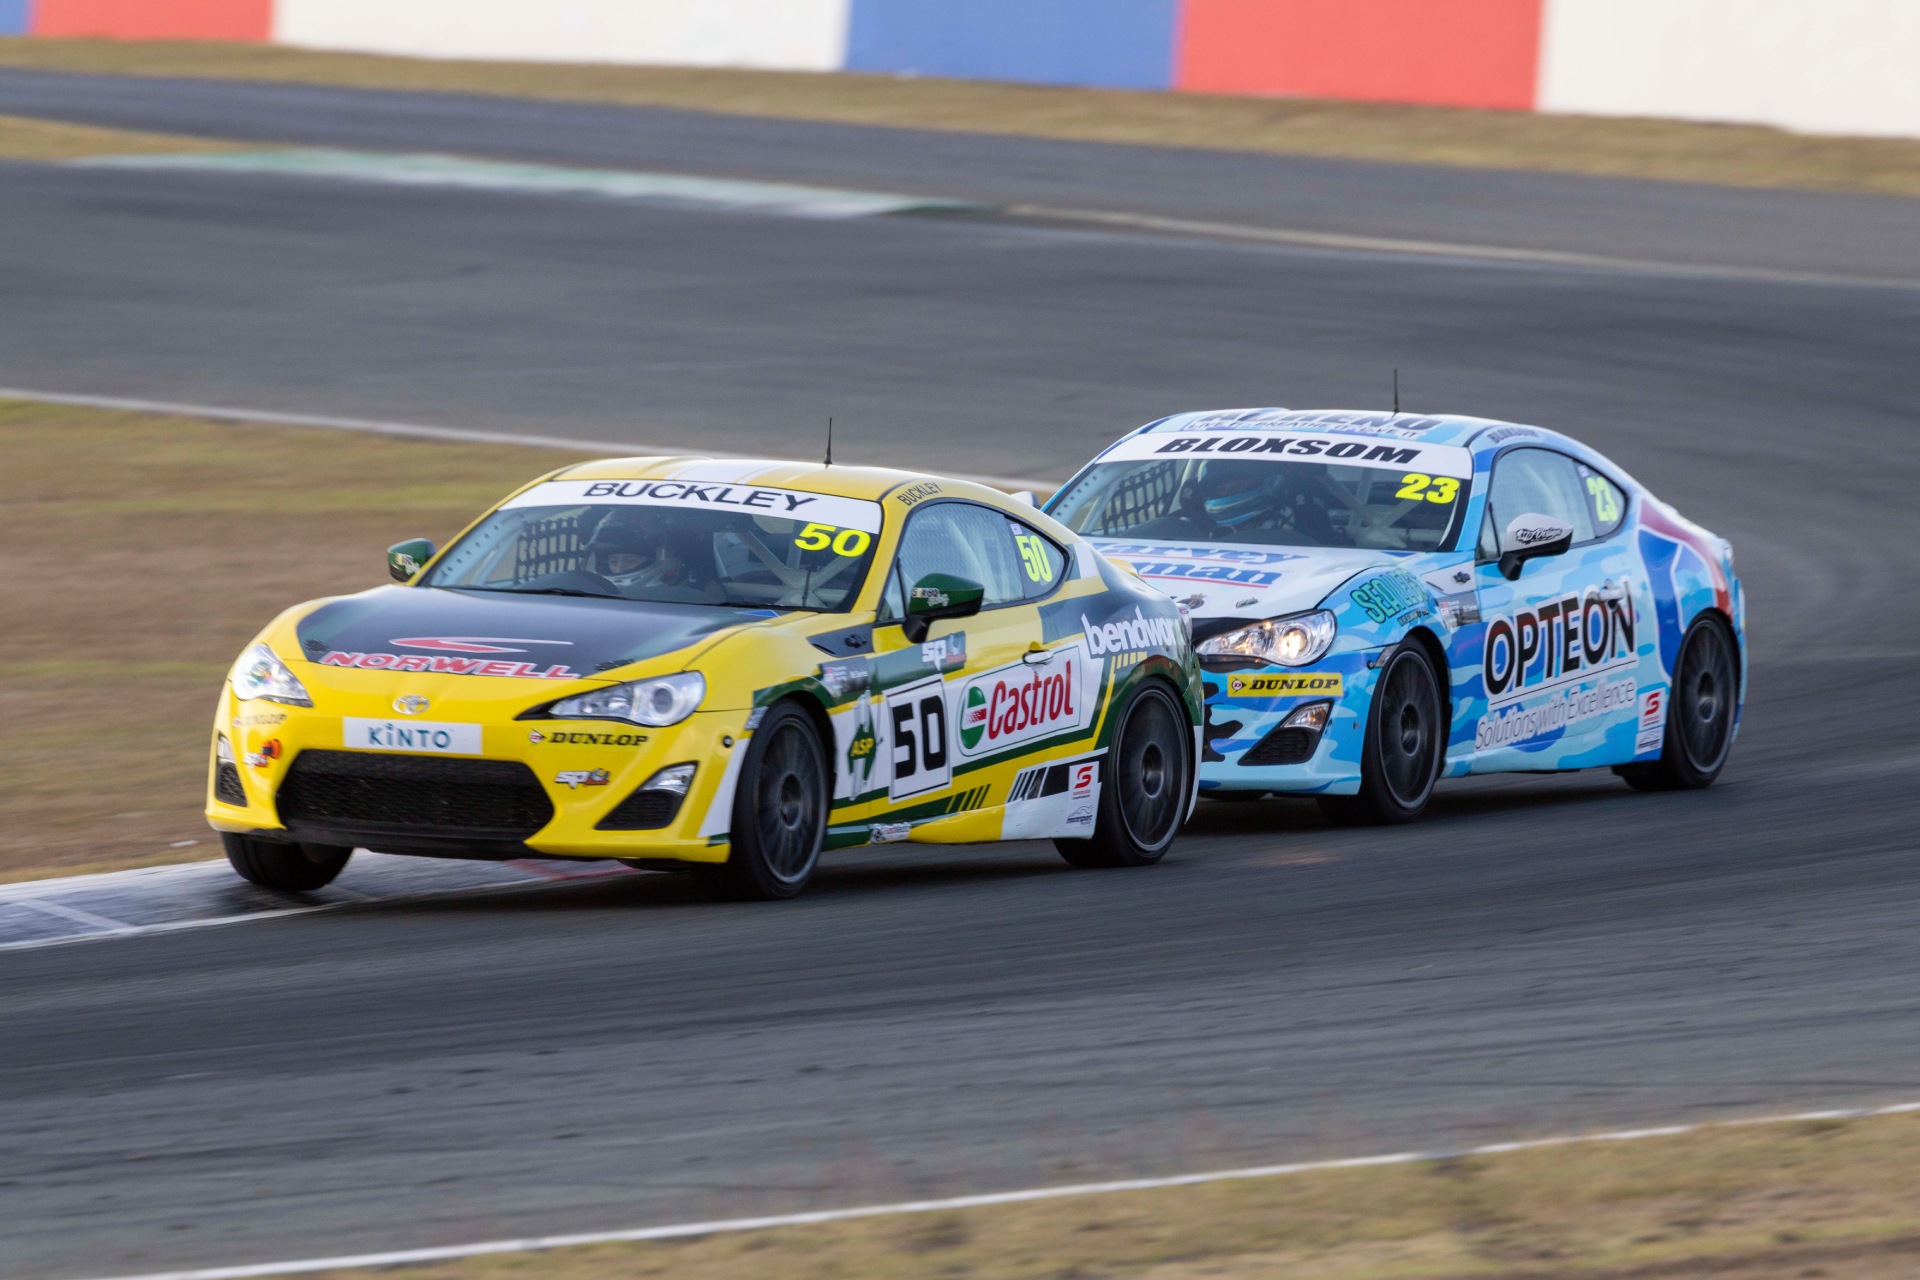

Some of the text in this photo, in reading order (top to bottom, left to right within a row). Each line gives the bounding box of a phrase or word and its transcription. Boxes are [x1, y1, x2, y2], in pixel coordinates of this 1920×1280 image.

[1154, 437, 1423, 464] BLOXSOM
[583, 482, 821, 512] BUCKLEY
[897, 481, 943, 506] BUCKLEY
[1394, 473, 1461, 504] 23
[1586, 476, 1619, 522] 23
[794, 522, 871, 558] 50
[1015, 534, 1053, 582] 50
[1483, 579, 1637, 696] OPTEON
[318, 651, 582, 679] NORWELL
[987, 660, 1074, 740] Castrol
[1249, 679, 1339, 690] DUNLOP
[1475, 680, 1635, 750] Solutions with Excellence
[548, 732, 649, 746] DUNLOP
[891, 694, 947, 780] 50
